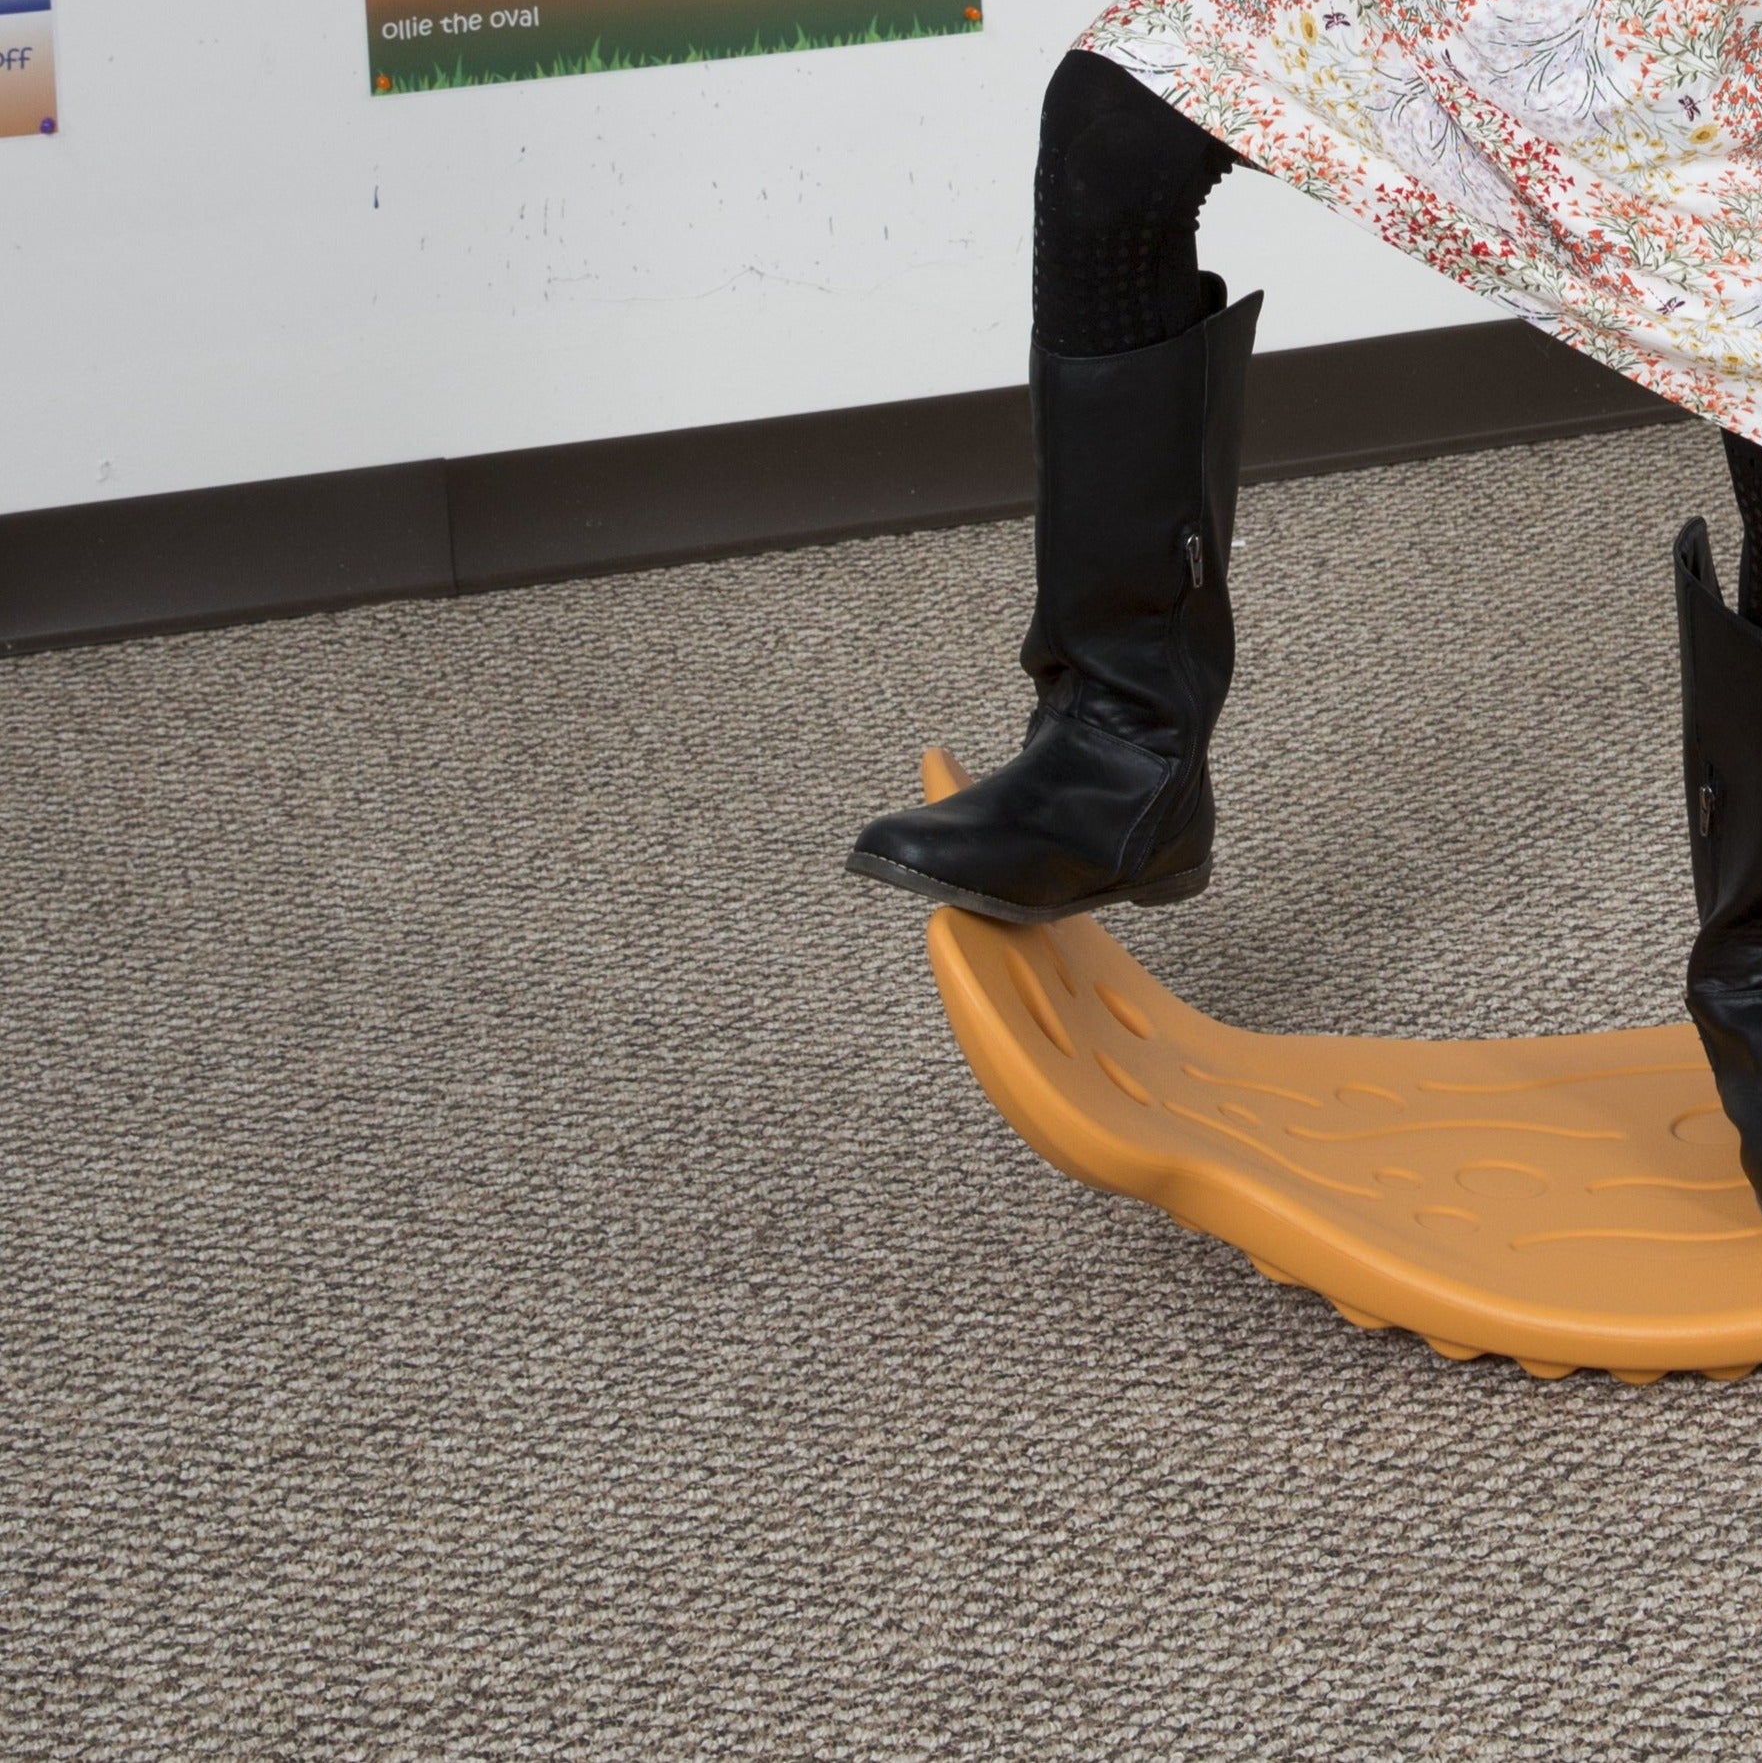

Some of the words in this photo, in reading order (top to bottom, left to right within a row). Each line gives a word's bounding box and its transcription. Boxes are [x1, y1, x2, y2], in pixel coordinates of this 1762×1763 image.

[382, 17, 433, 39] ollie
[440, 13, 482, 34] the
[490, 6, 539, 28] oval
